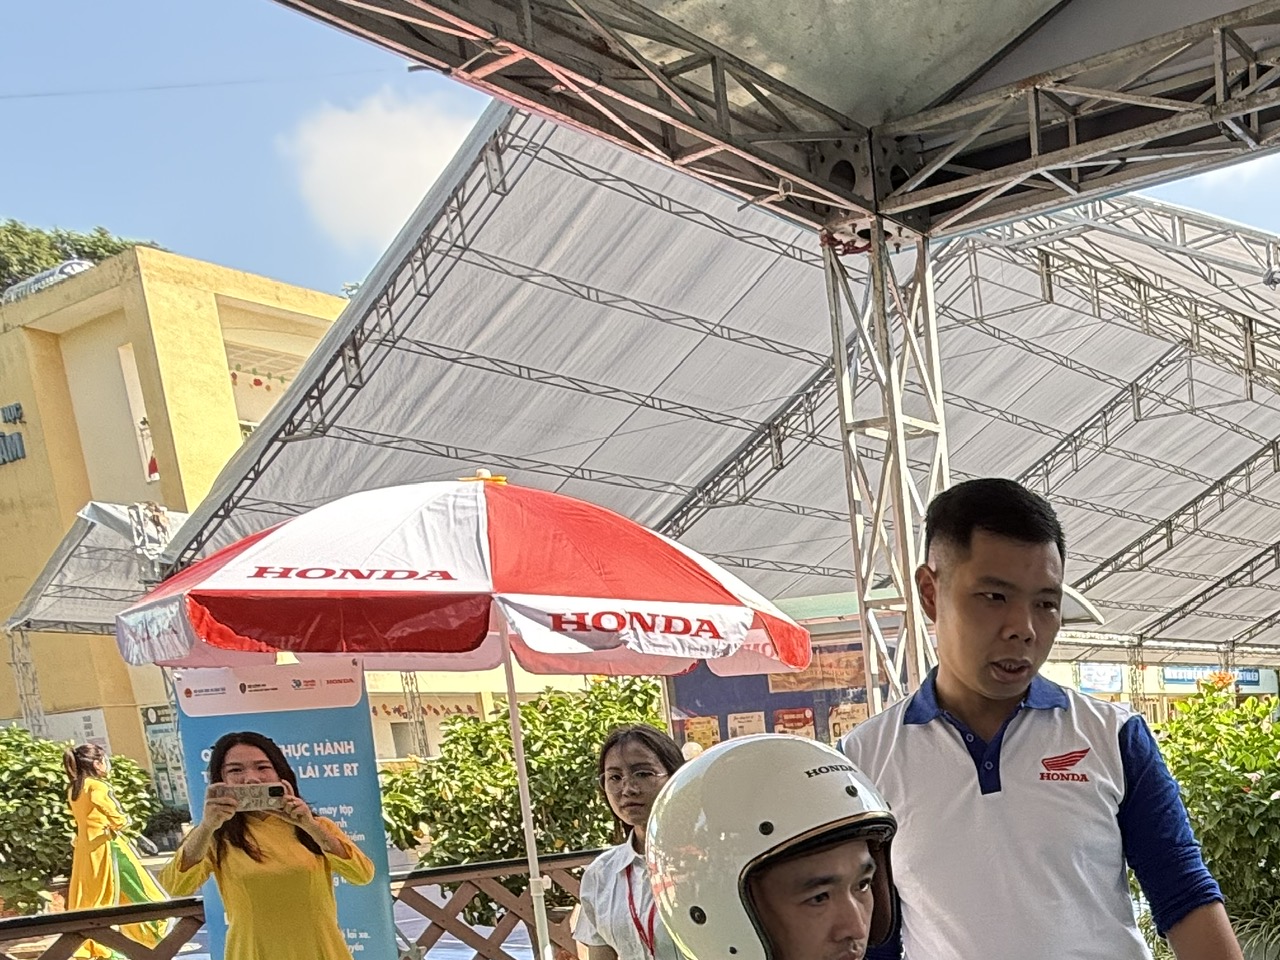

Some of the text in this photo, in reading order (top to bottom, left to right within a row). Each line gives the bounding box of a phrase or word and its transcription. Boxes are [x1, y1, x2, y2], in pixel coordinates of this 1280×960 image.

[247, 566, 457, 581] HONDA
[547, 611, 725, 640] HONDA
[314, 738, 355, 756] HÀNH
[299, 762, 359, 779] LÁI XE RT
[803, 764, 858, 778] HONDA
[1039, 772, 1089, 782] HONDA
